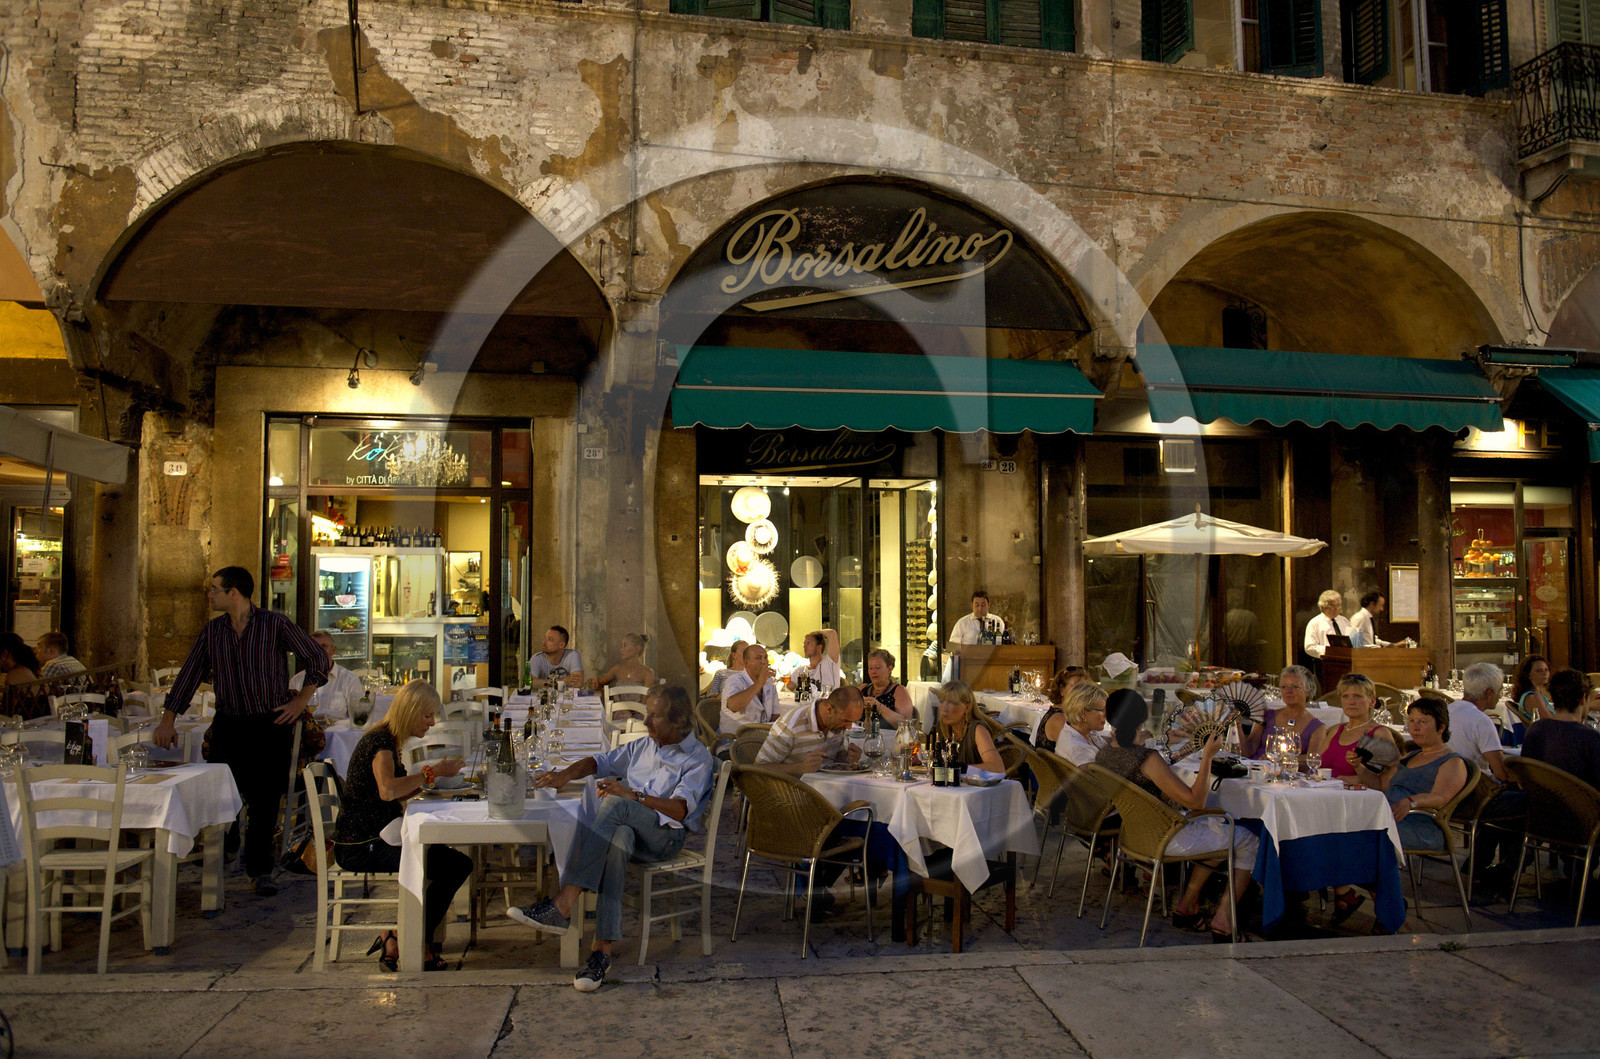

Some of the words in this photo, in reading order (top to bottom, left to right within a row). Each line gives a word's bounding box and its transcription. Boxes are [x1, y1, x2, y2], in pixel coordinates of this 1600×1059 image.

[720, 207, 1013, 311] Borsalino
[745, 429, 896, 471] Borsalino
[346, 475, 355, 486] by
[356, 474, 377, 485] CITTÀ
[379, 475, 386, 485] DI
[1001, 461, 1015, 472] 28
